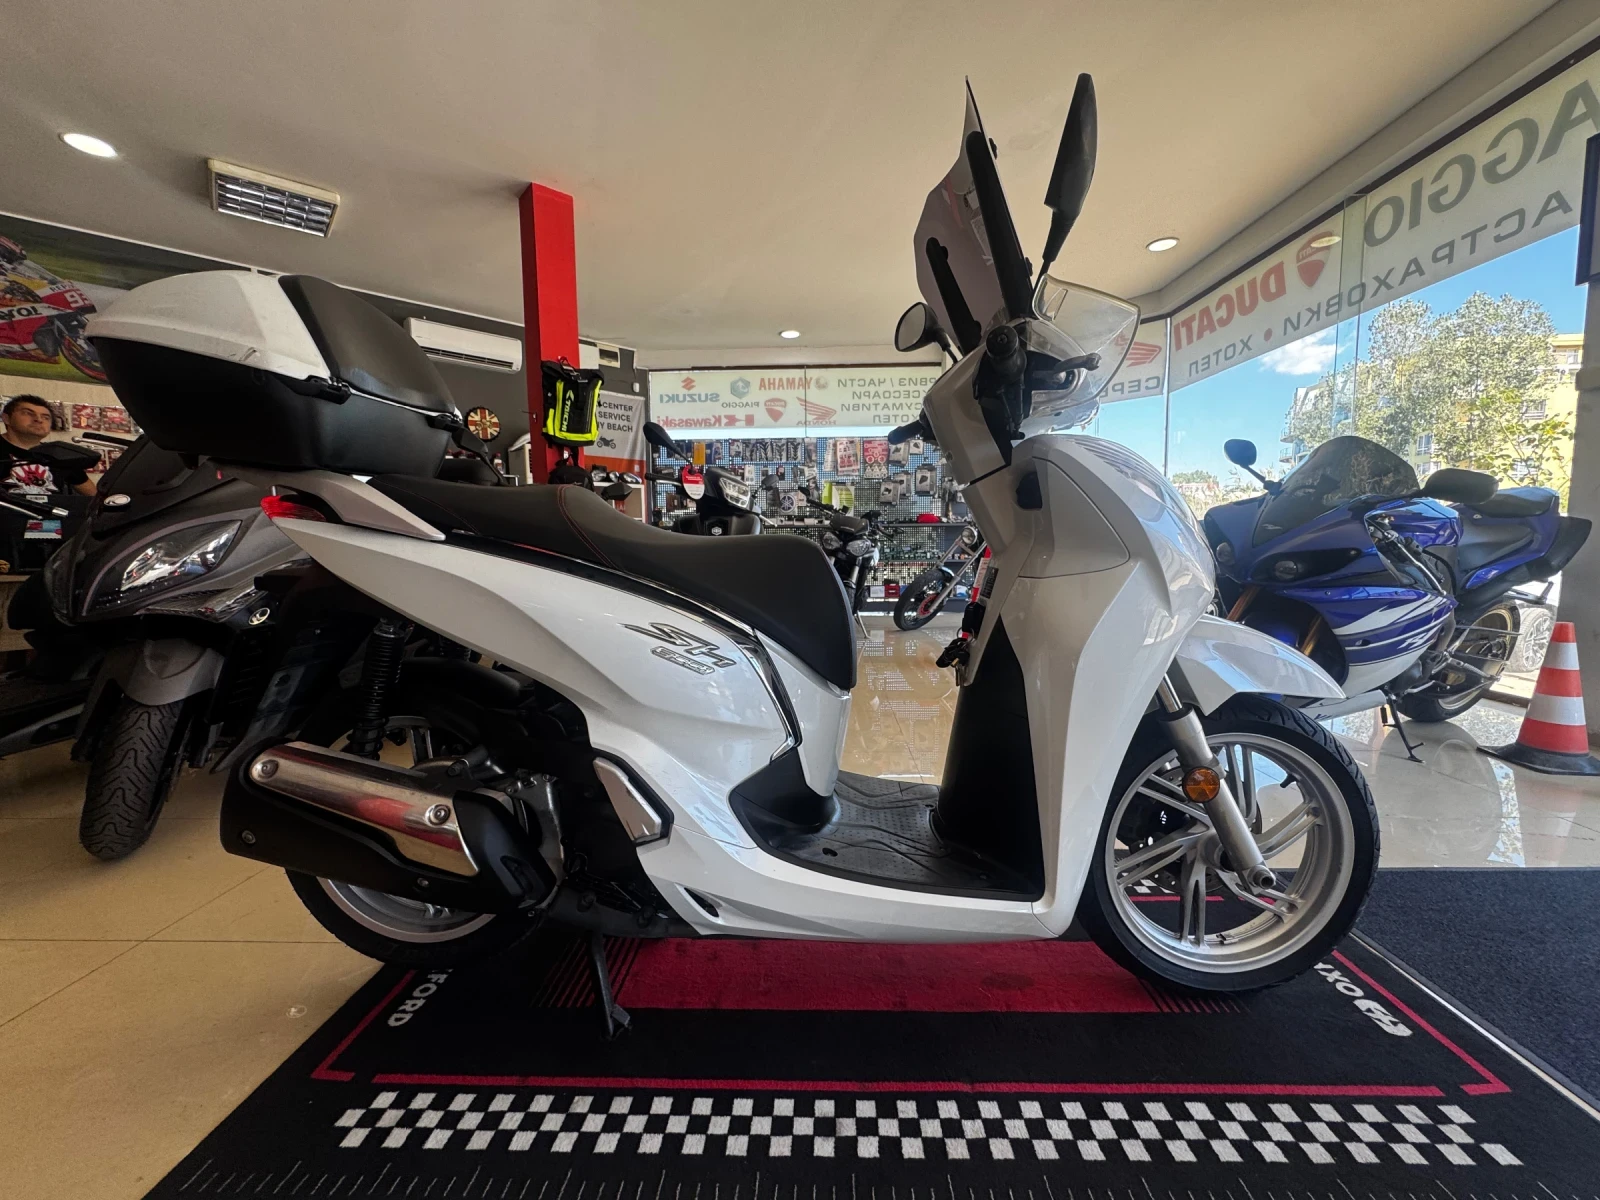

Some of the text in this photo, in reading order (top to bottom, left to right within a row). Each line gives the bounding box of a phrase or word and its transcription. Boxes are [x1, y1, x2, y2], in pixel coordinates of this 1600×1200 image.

[602, 401, 634, 412] CENTER
[598, 411, 631, 422] SERVICE
[607, 422, 633, 433] BEACH
[387, 968, 454, 1027] FORD
